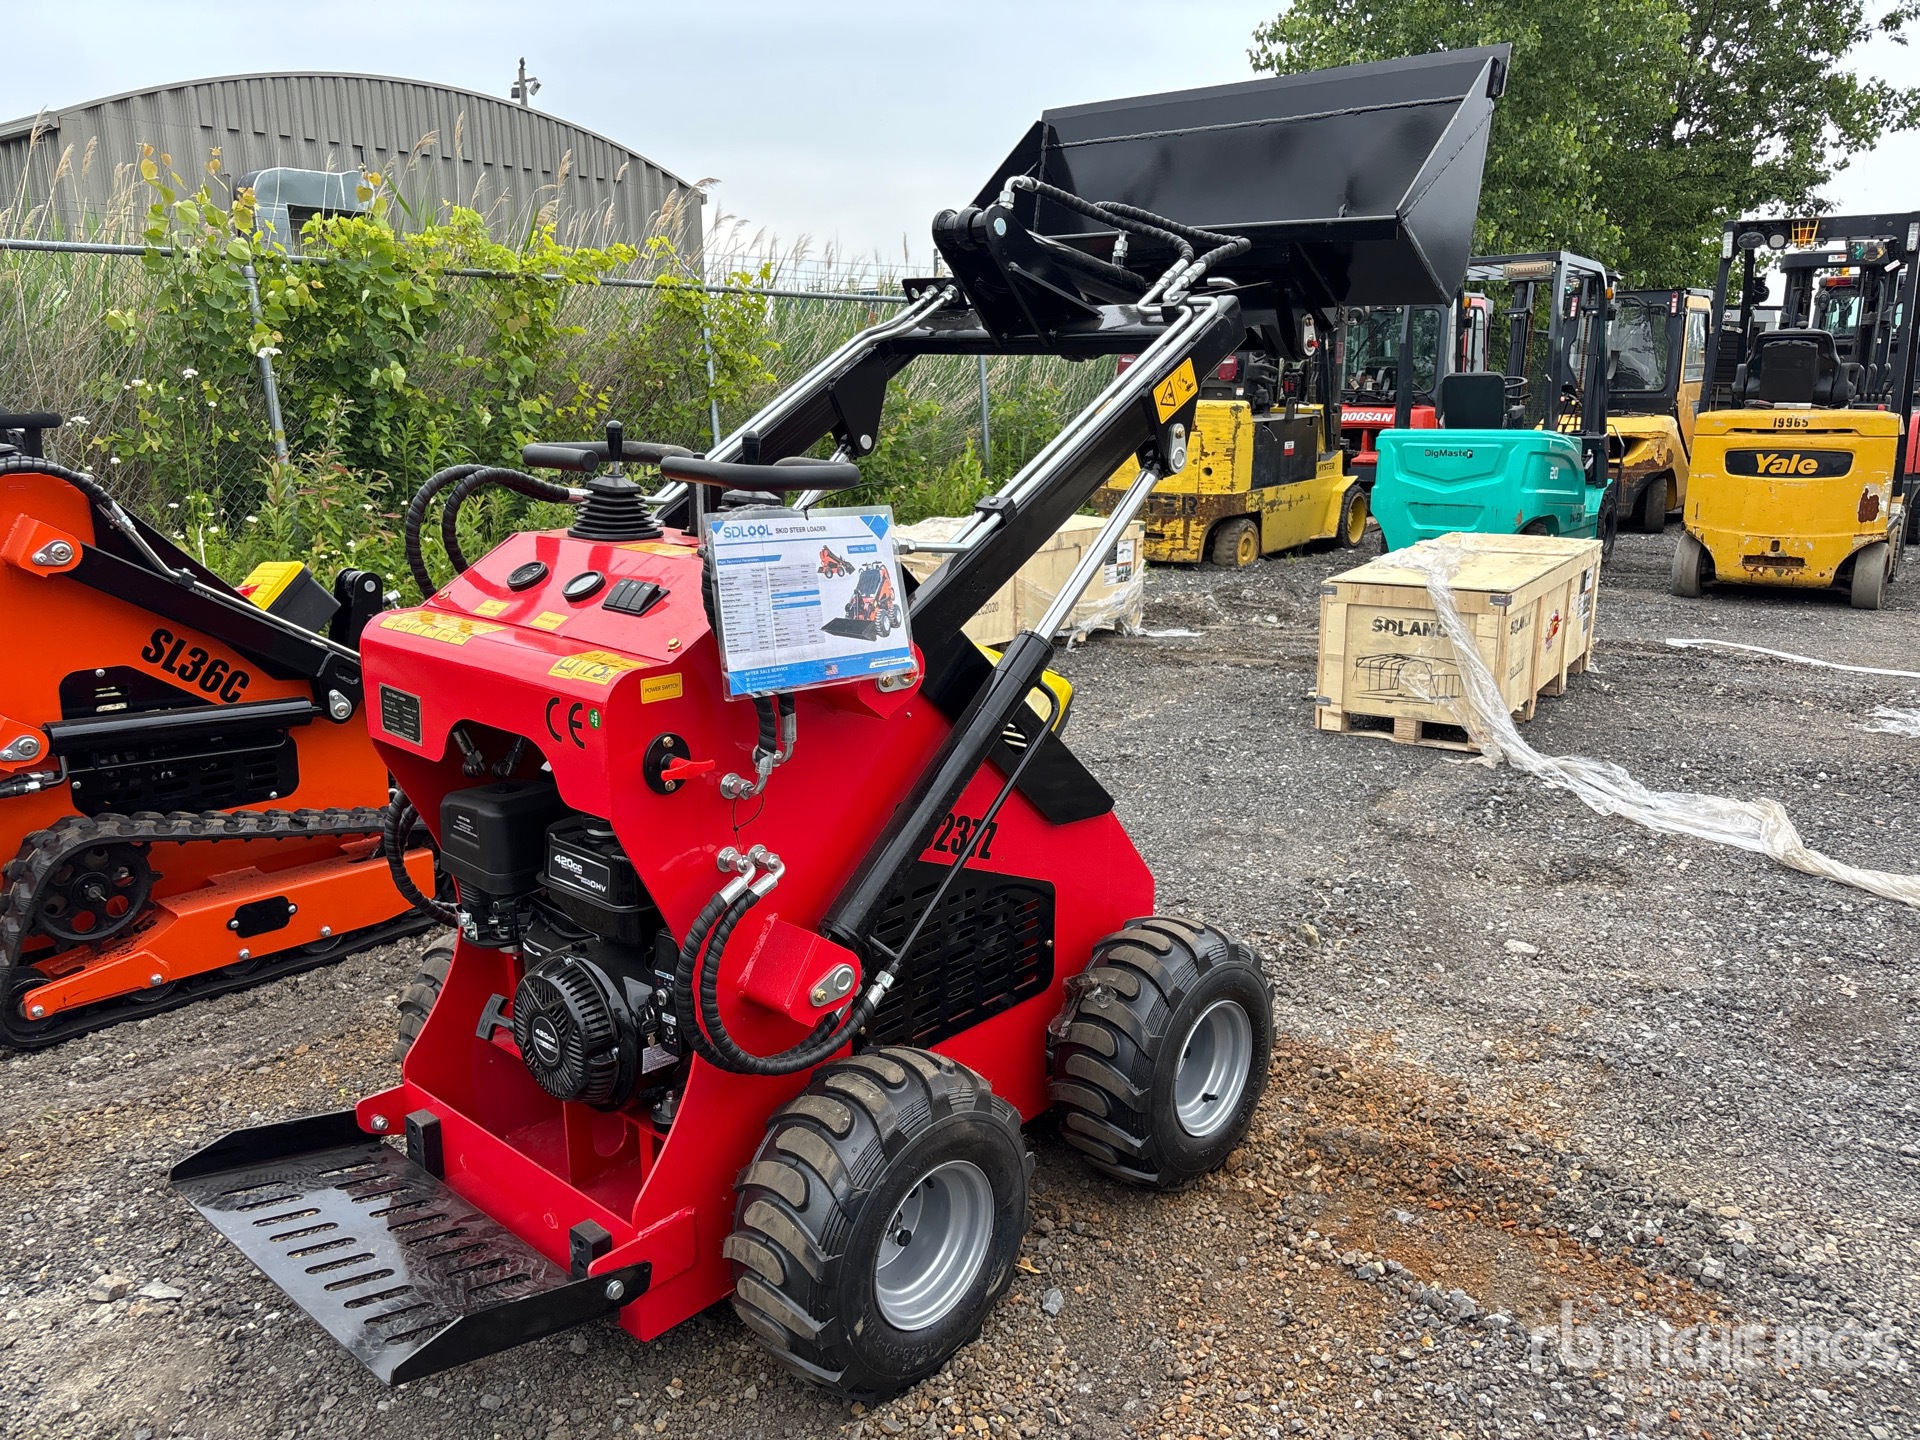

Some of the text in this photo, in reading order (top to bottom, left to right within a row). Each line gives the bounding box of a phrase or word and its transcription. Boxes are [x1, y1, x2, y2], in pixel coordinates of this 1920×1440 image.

[1341, 411, 1393, 423] DOOSAN
[1773, 417, 1809, 429] 19965
[1425, 448, 1473, 459] DigMaster
[1318, 462, 1335, 472] HYSTER
[1755, 453, 1819, 475] Yale
[1550, 466, 1559, 480] 20
[723, 524, 826, 539] SDLOOL SKID STEER LOADER
[141, 627, 251, 704] SL36C
[645, 682, 679, 694] POWER SWITCH
[554, 854, 582, 872] 420cc
[590, 880, 606, 893] OHV
[535, 1028, 556, 1044] 420cc
